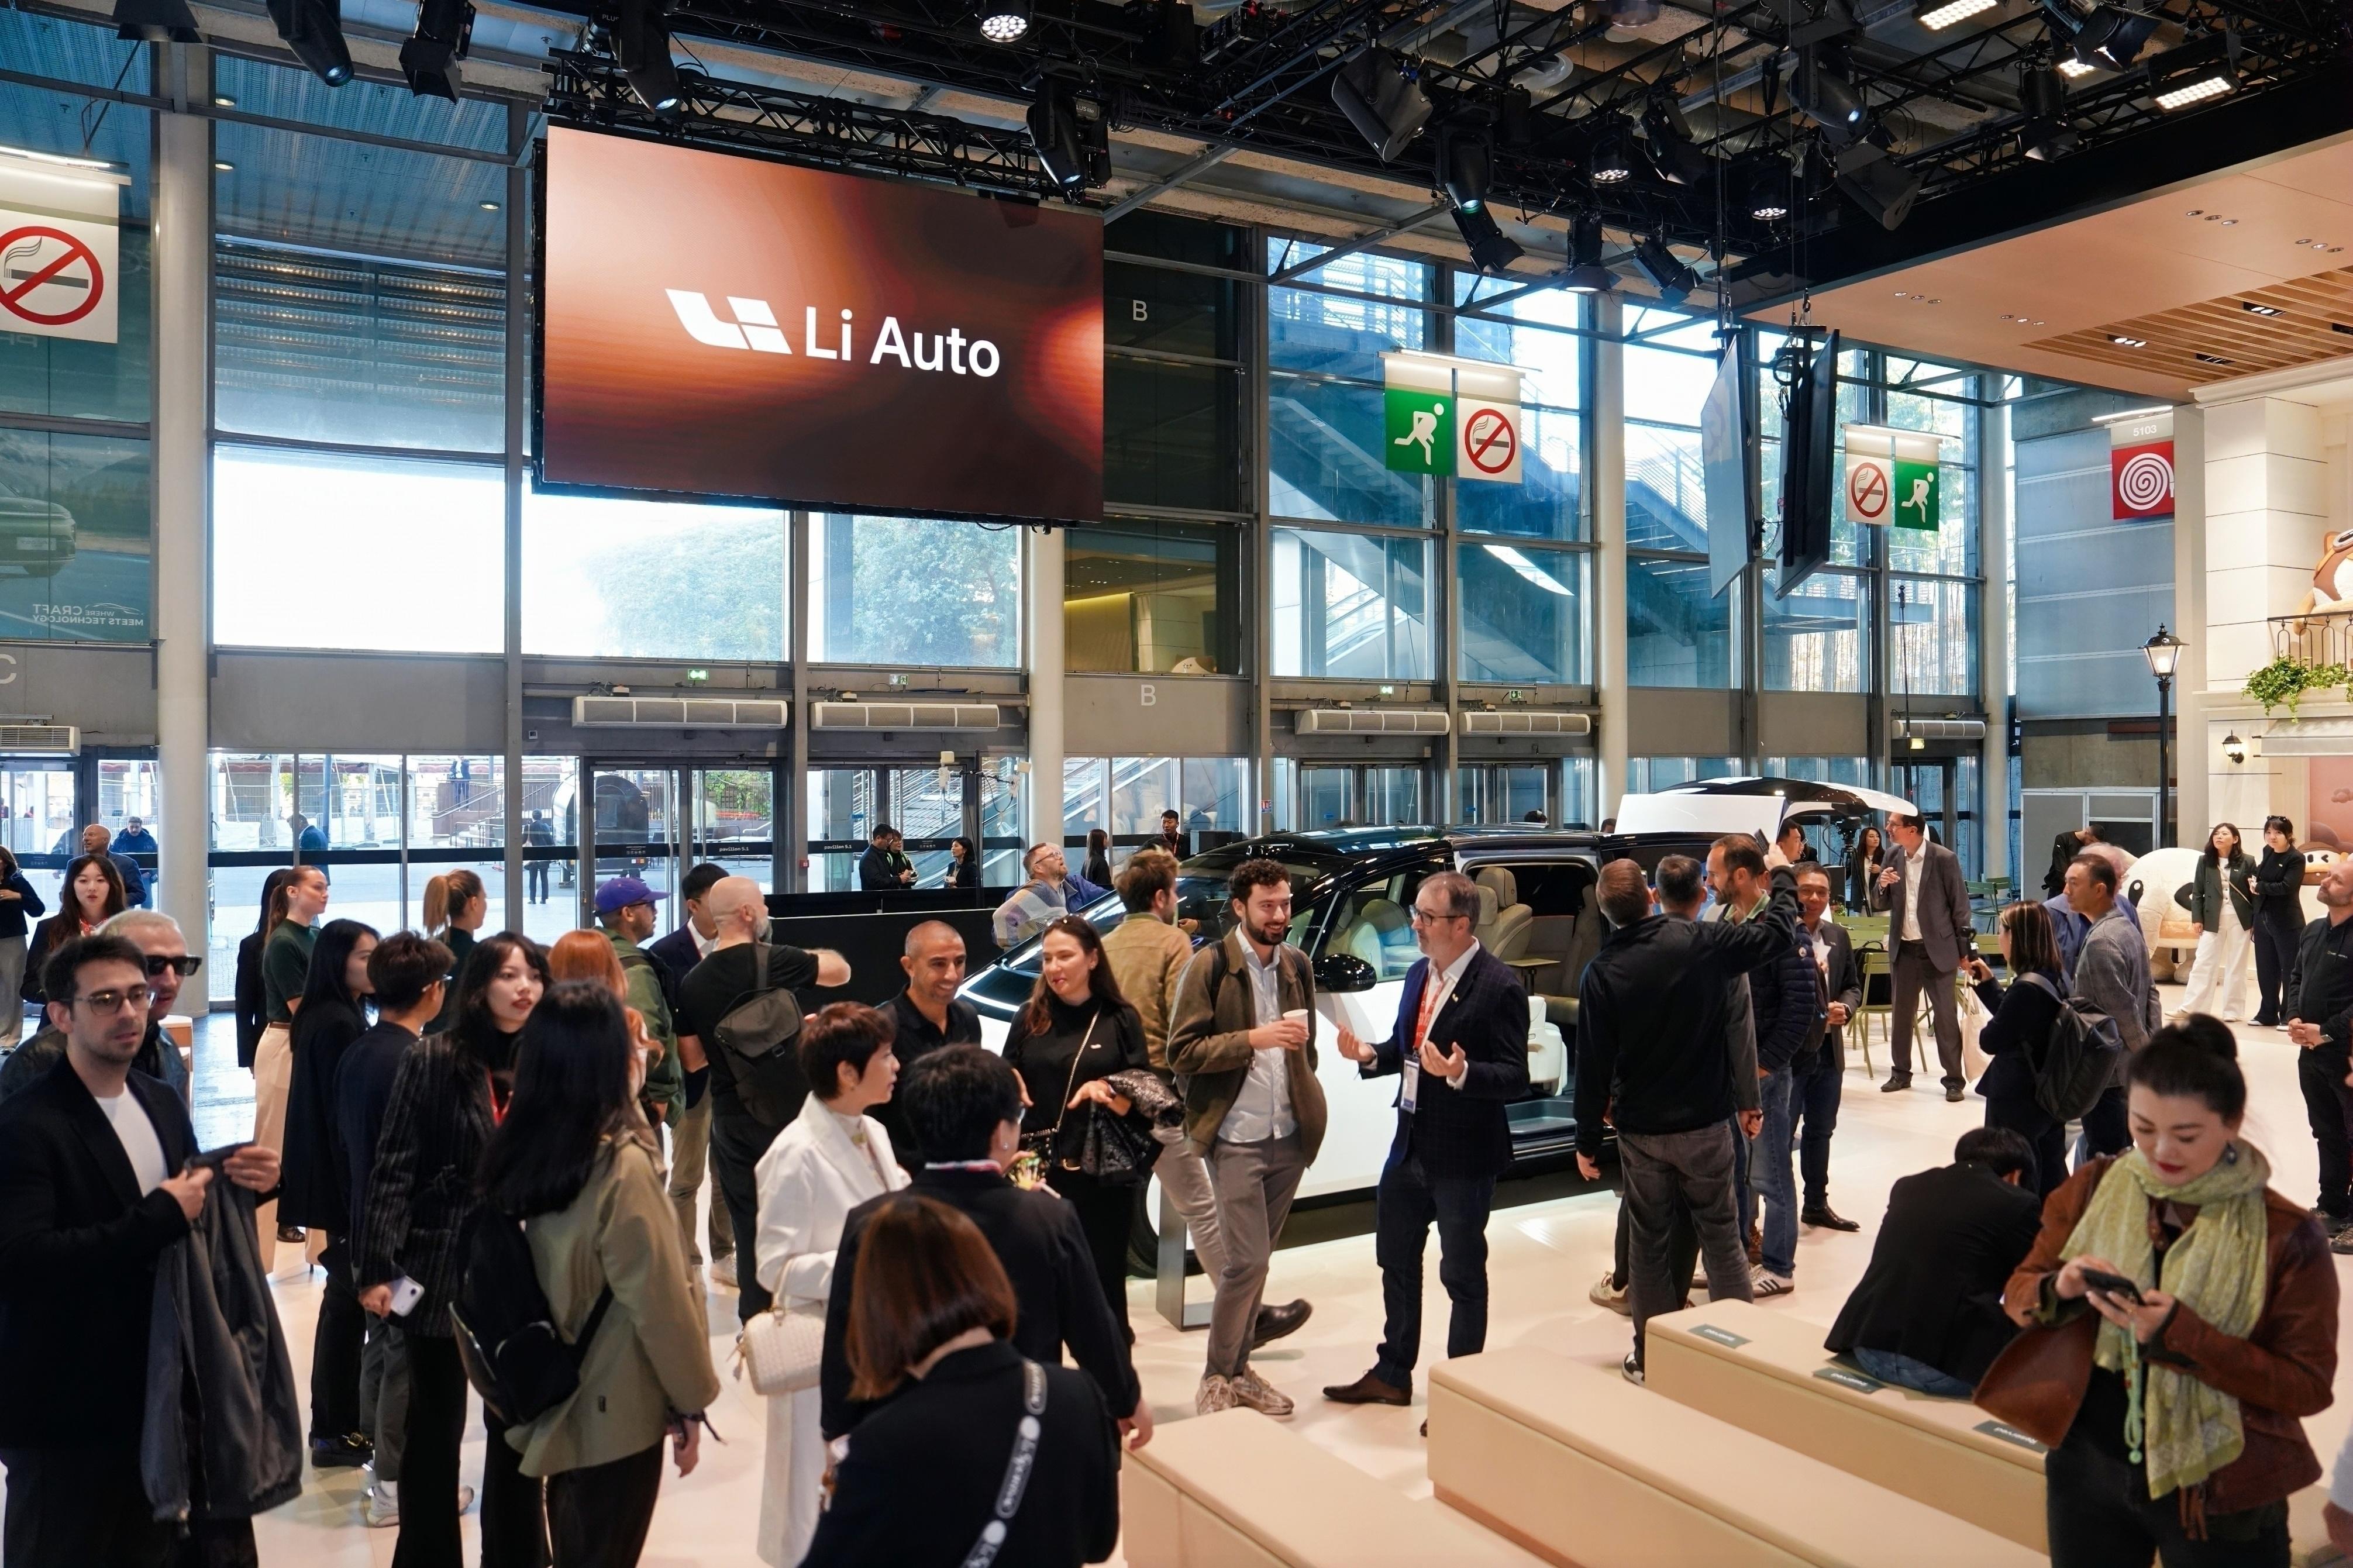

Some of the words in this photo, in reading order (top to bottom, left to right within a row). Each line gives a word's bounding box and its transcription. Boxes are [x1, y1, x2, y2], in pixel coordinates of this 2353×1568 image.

[1132, 299, 1148, 322] B
[805, 305, 853, 361] Li
[869, 316, 1001, 378] Auto
[2133, 425, 2157, 437] 5103
[1141, 684, 1157, 707] B
[1993, 1427, 2038, 1444] Reserved
